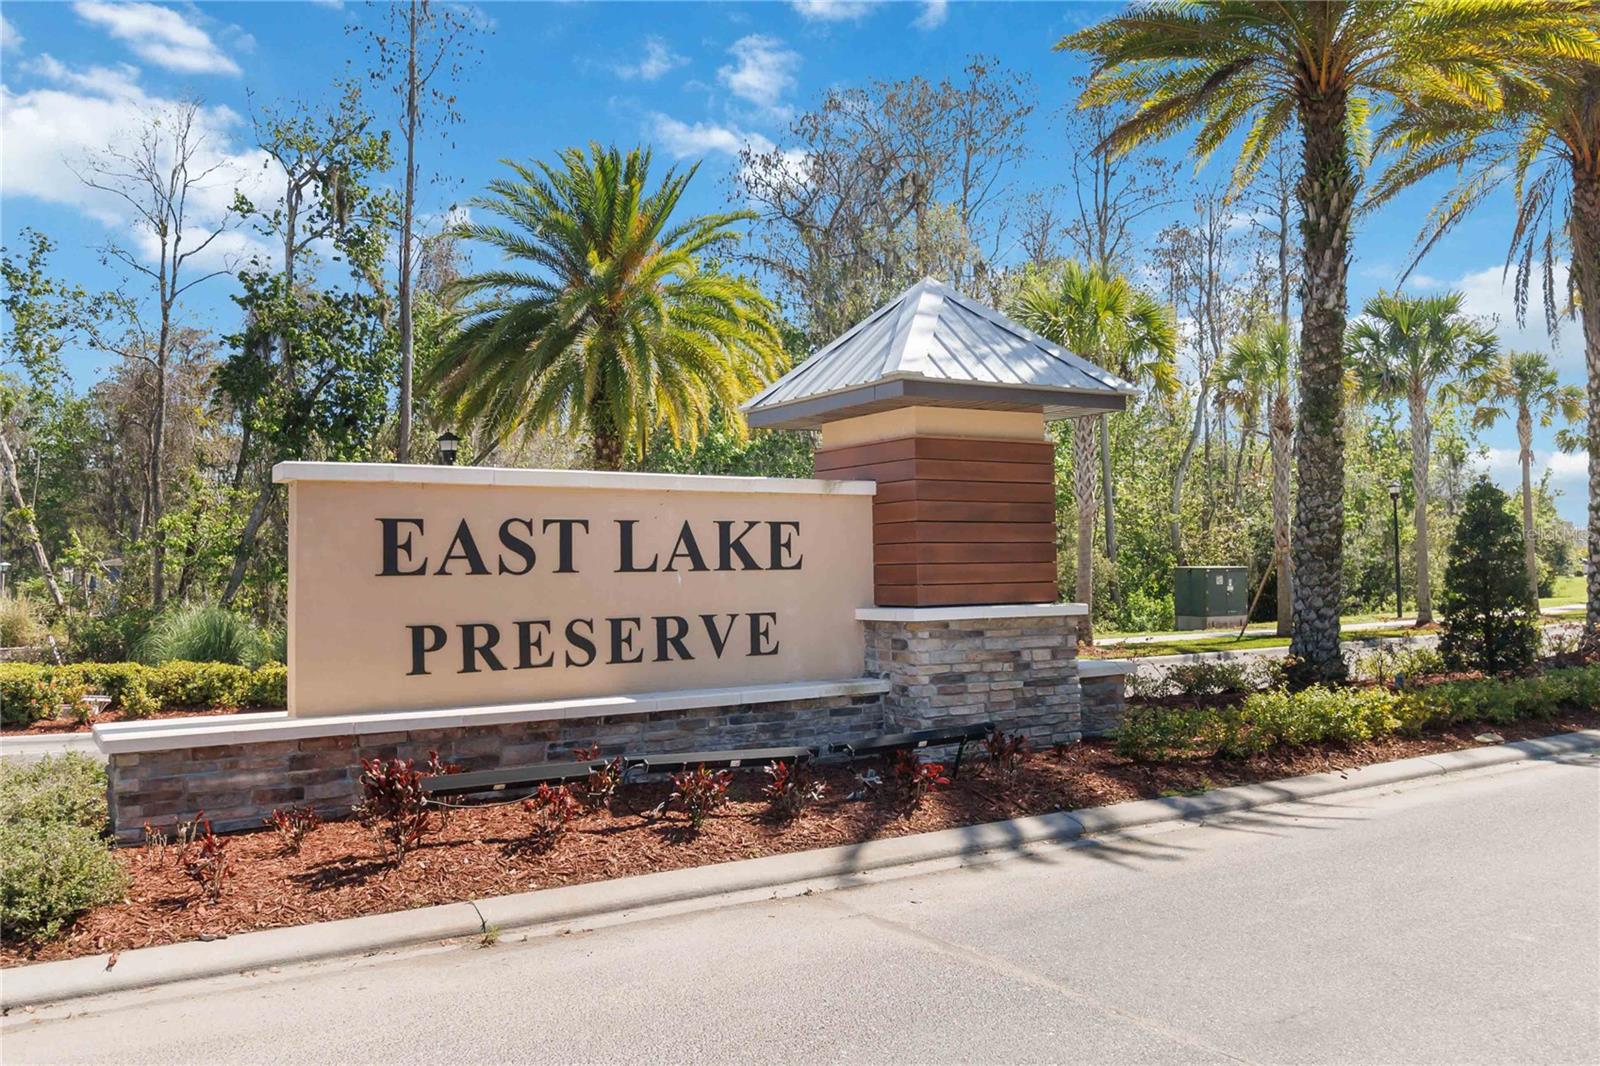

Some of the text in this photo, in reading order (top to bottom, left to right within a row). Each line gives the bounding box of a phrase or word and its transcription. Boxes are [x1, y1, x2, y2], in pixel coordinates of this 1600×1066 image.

[375, 518, 804, 577] EAST LAKE
[405, 611, 780, 677] PRESERVE
